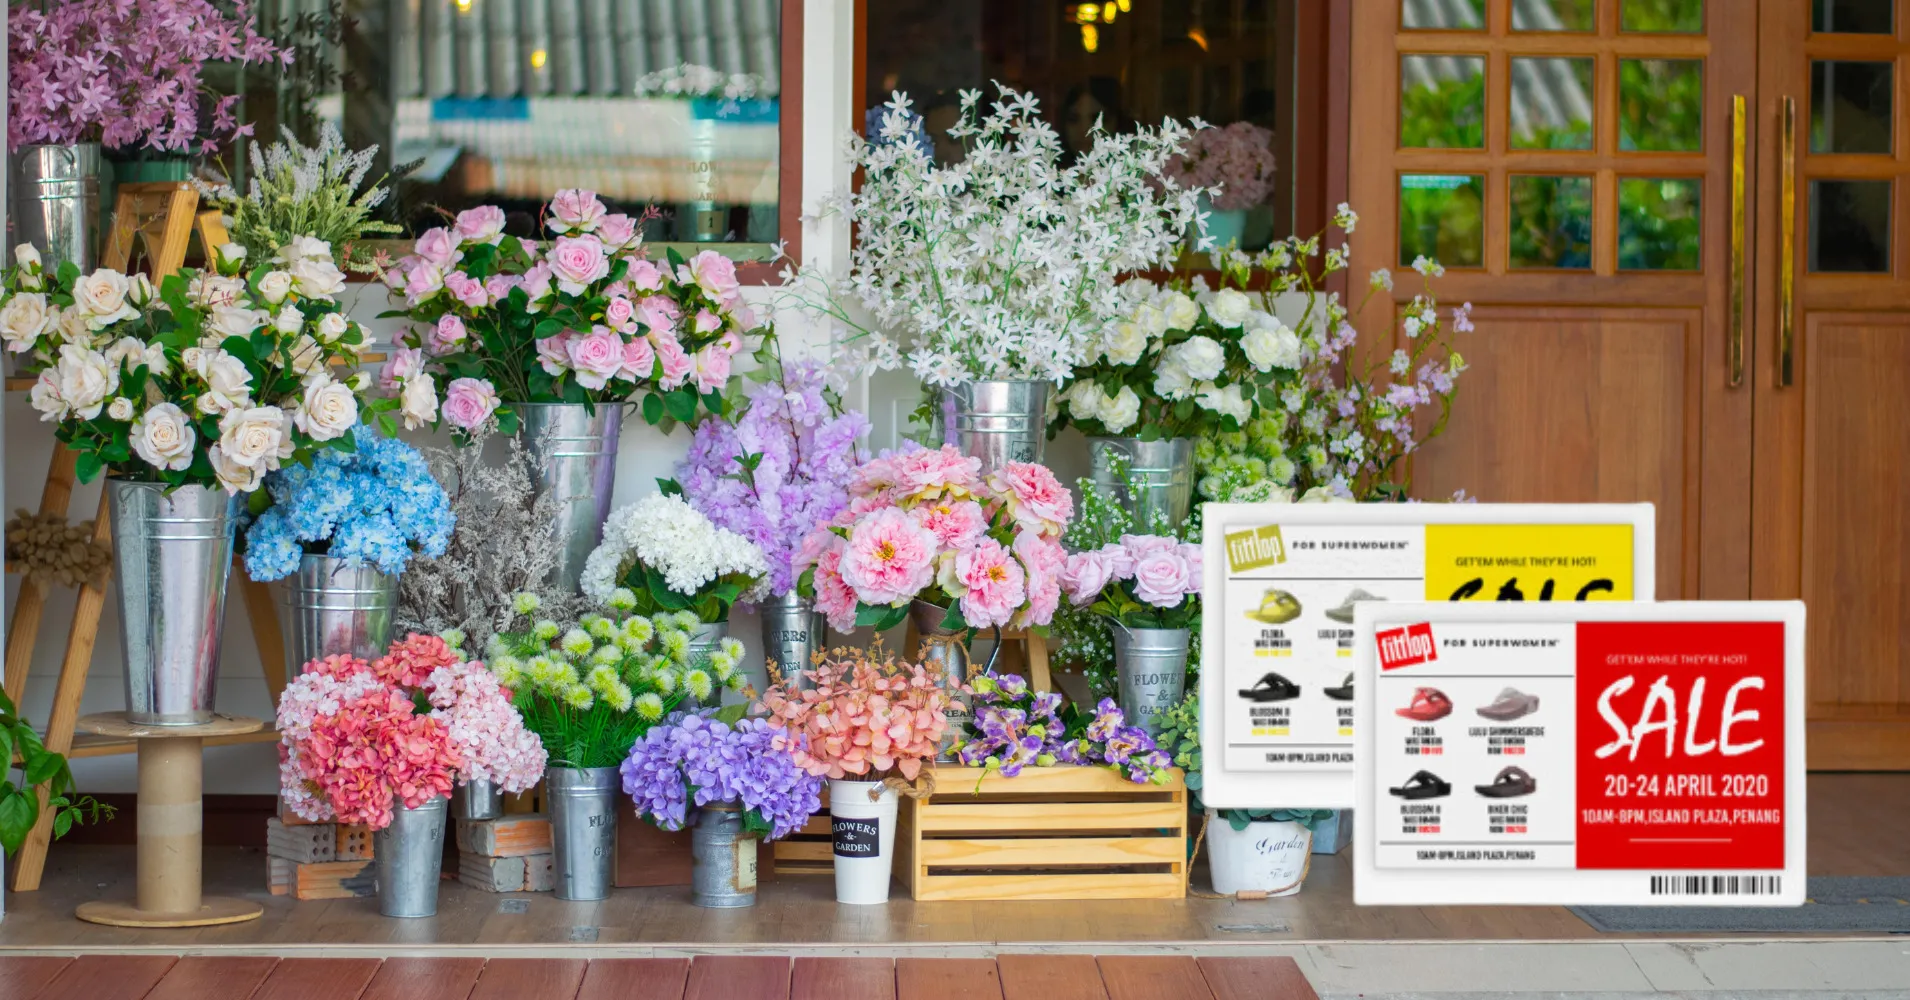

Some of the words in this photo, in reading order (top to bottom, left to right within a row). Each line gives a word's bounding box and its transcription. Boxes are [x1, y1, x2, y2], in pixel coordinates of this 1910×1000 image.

[1292, 541, 1316, 550] FOR
[1496, 557, 1527, 567] WHILE
[1571, 557, 1596, 567] HOT!
[1381, 625, 1432, 663] fitflop
[1443, 639, 1467, 648] FOR
[1606, 654, 1645, 665] GET'EM
[1647, 654, 1678, 665] WHILE
[1680, 654, 1720, 665] THEY'RE
[1723, 654, 1748, 665] HOT!
[1595, 675, 1765, 762] SALE
[1604, 774, 1660, 797] 20-24
[1664, 774, 1716, 797] APRIL
[1721, 774, 1768, 797] 2020
[832, 821, 877, 836] FLOWERS
[835, 842, 871, 852] GARDEN
